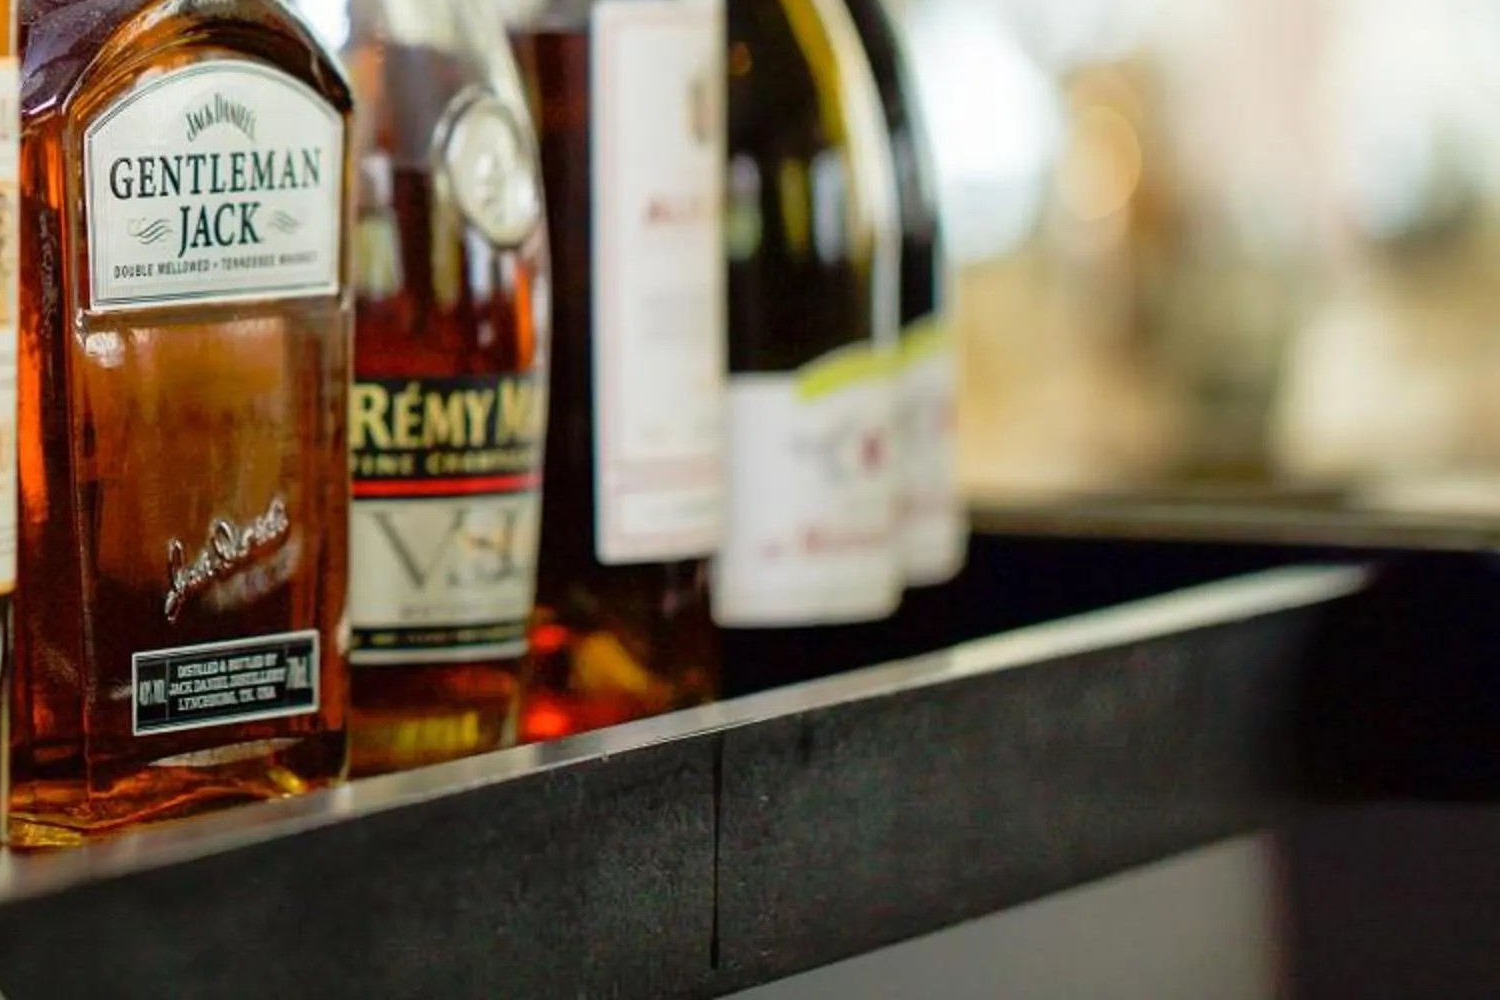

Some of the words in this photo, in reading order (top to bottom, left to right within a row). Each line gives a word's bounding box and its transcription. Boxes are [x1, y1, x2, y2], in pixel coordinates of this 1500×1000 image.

[109, 148, 323, 200] GENTLEMAN
[177, 202, 262, 258] JACK
[113, 263, 154, 279] DOUBLE
[157, 258, 210, 275] MELLOWED
[351, 381, 495, 450] RÉMY
[169, 681, 193, 697] JACK
